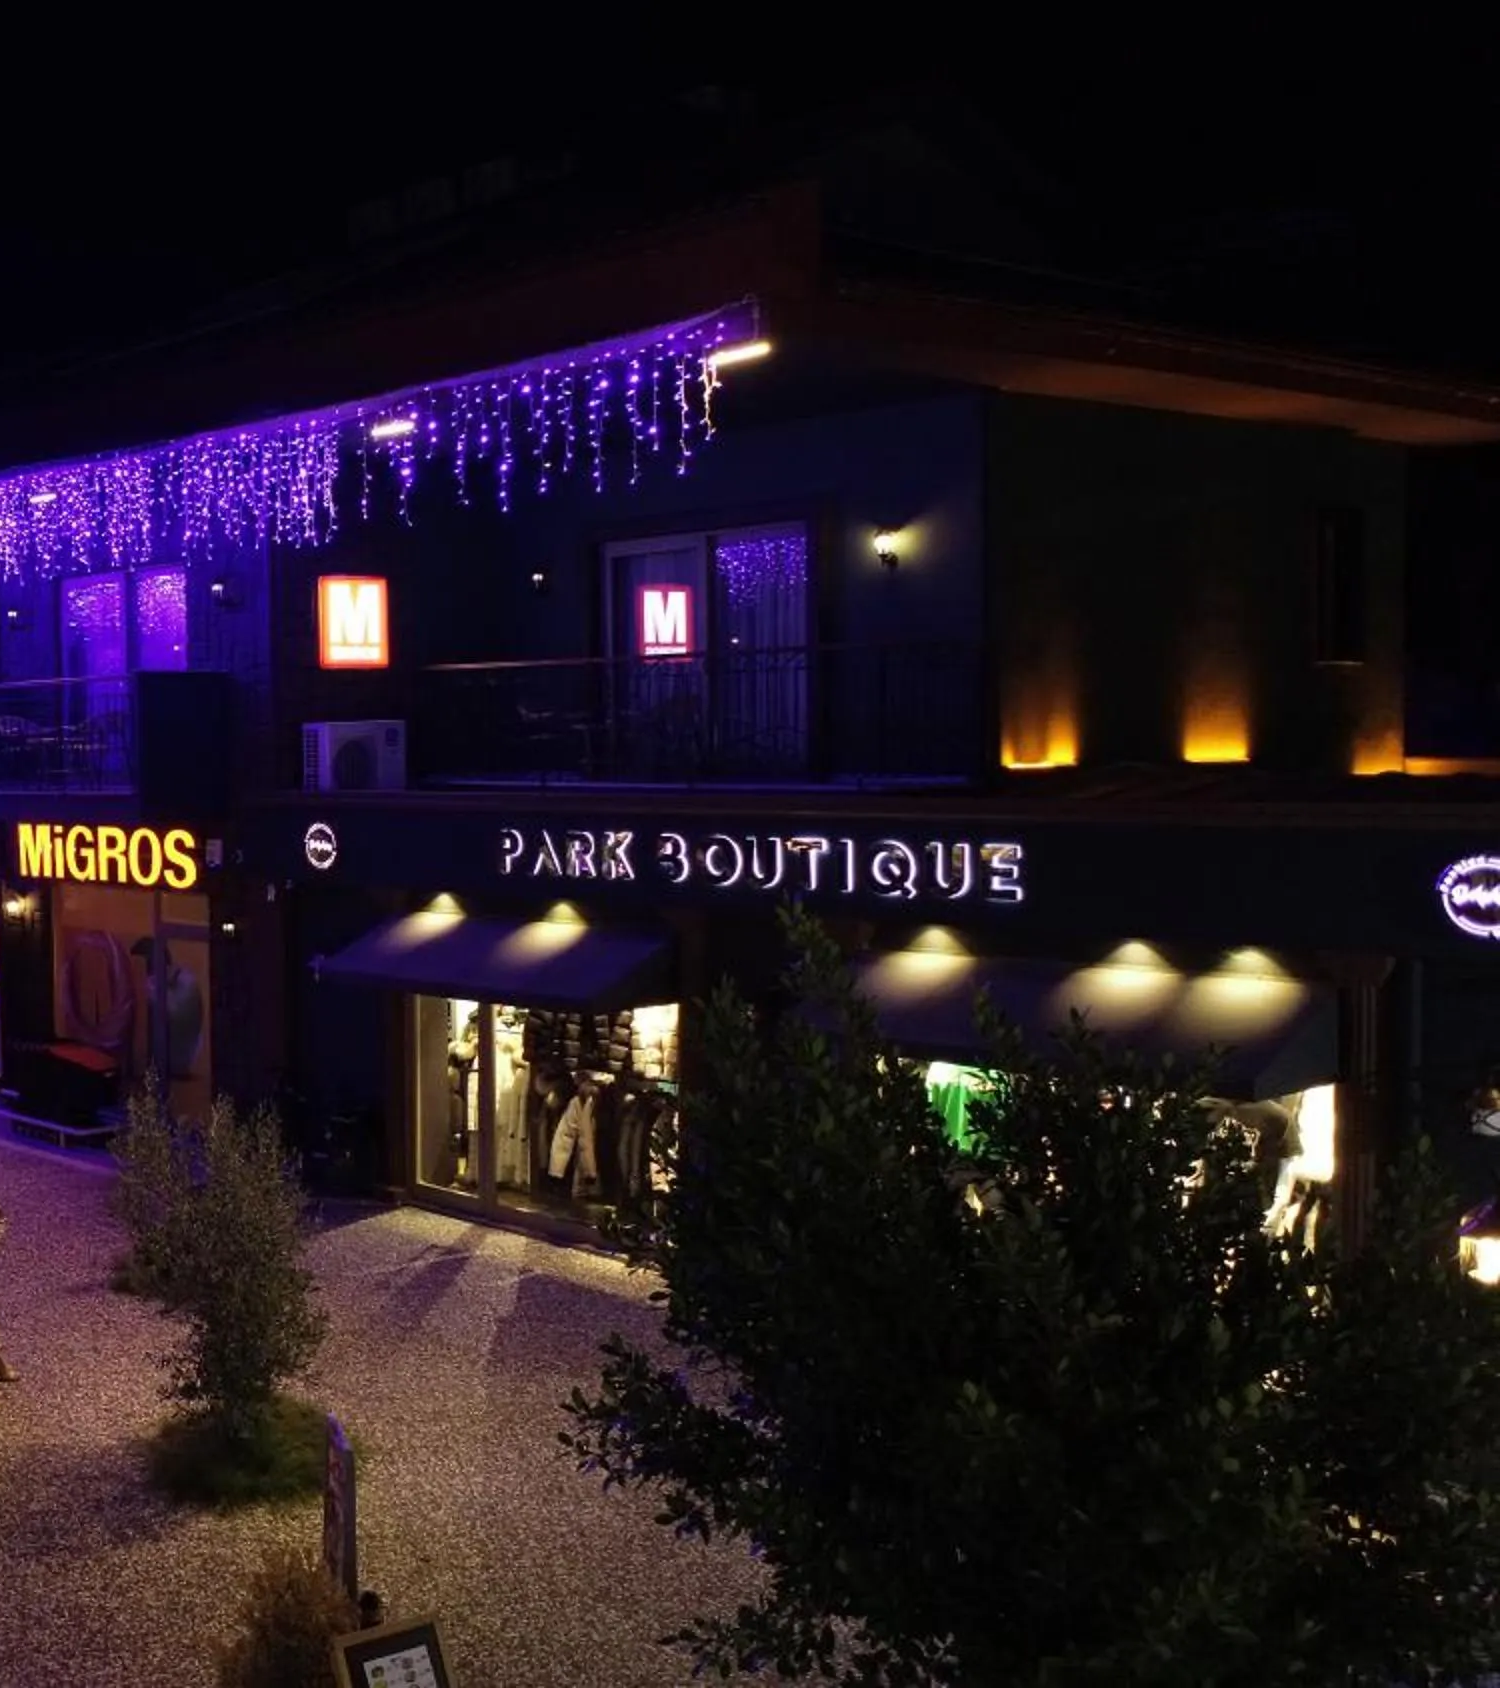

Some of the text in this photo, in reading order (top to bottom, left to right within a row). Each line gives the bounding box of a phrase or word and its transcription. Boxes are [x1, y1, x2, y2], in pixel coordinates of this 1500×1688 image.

[328, 582, 381, 645] M
[643, 591, 686, 643] M
[499, 828, 1024, 902] PARK BOUTIQUE
